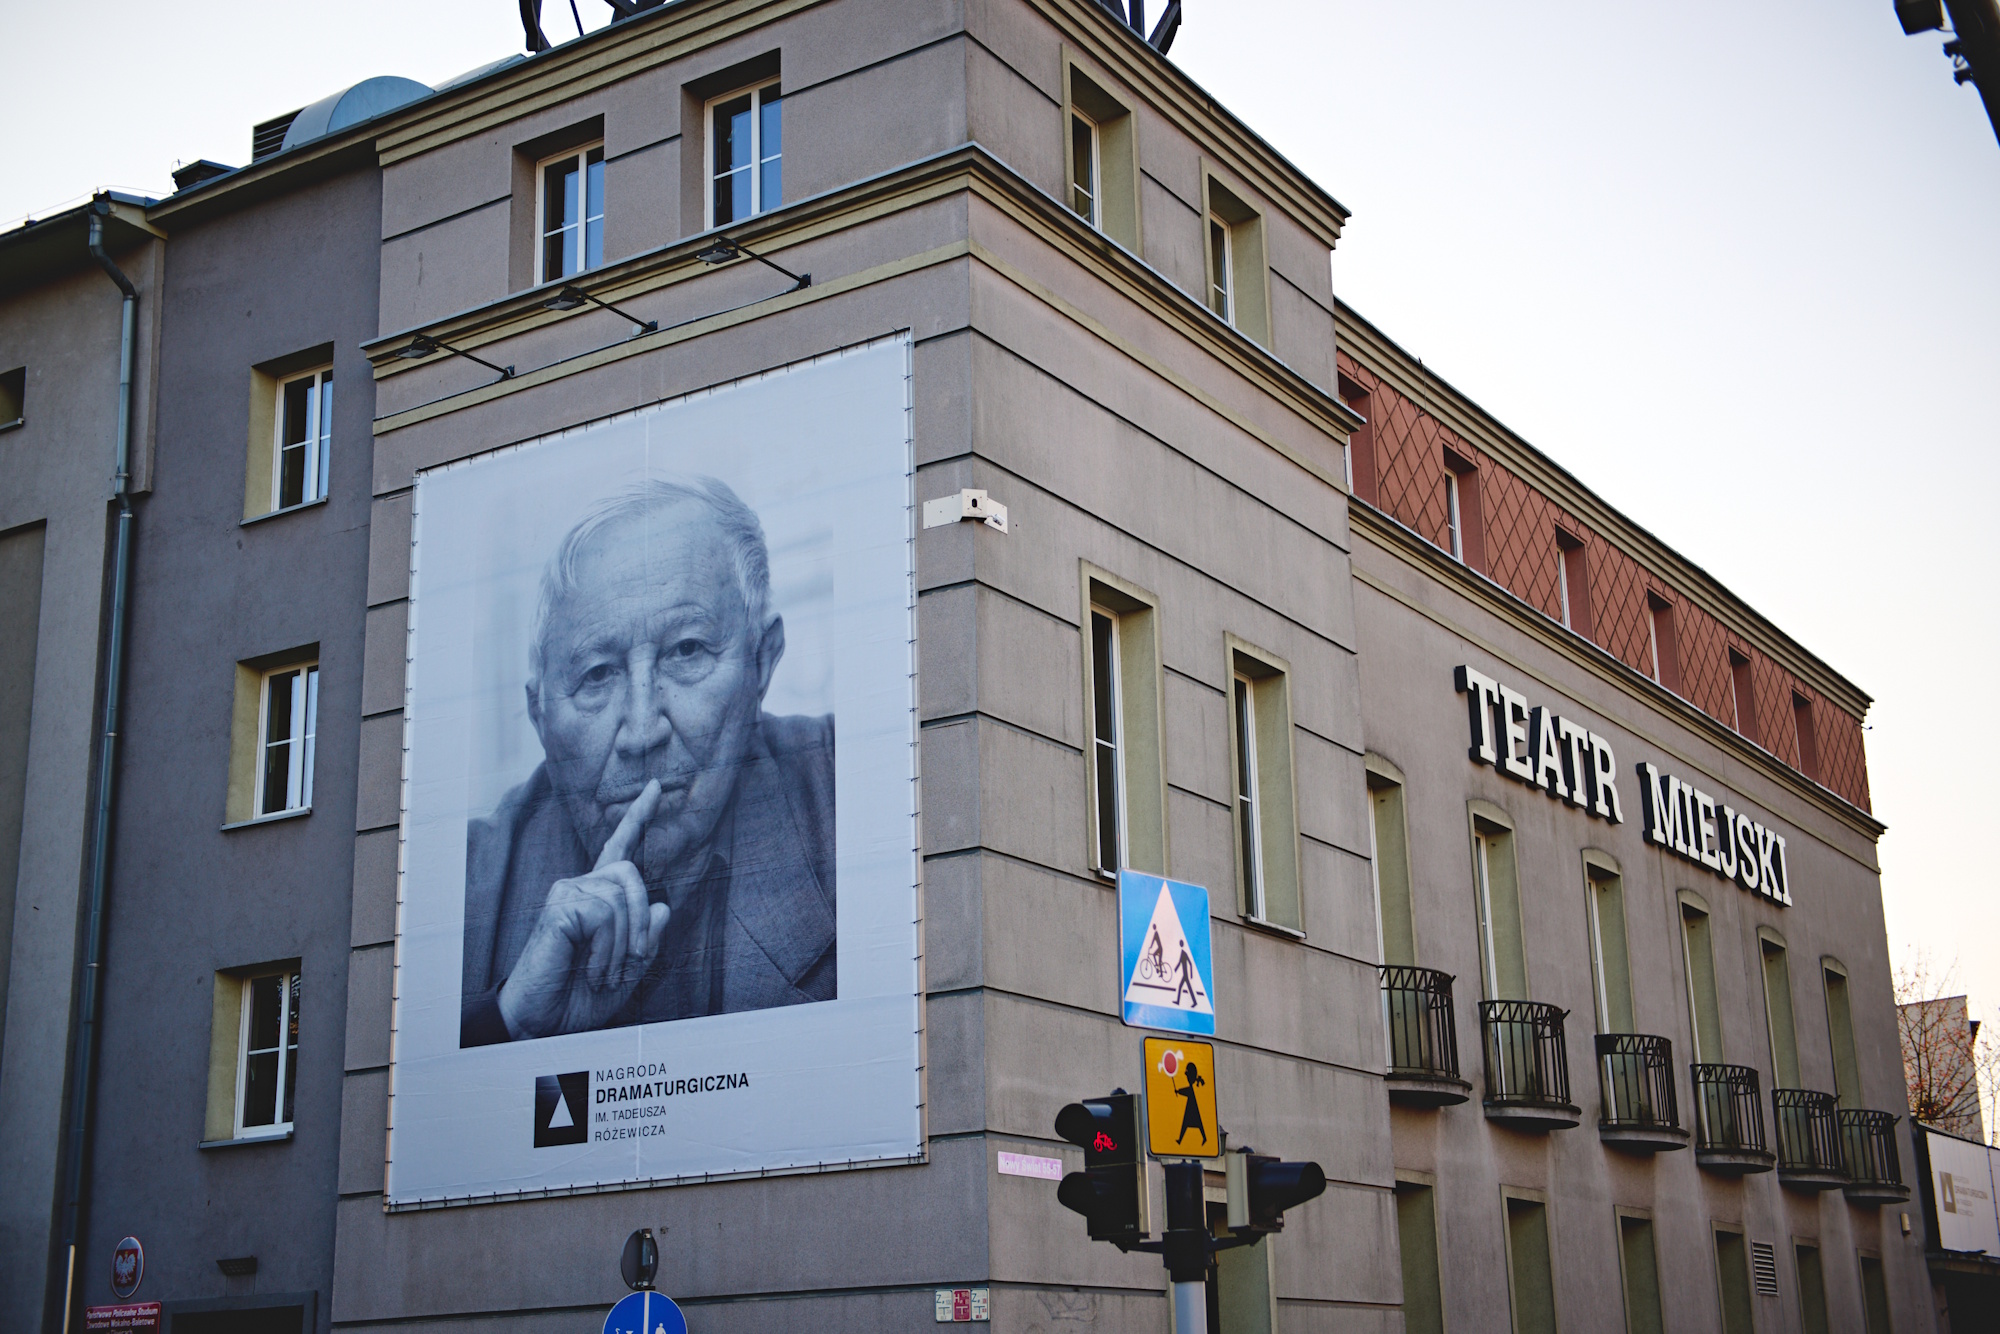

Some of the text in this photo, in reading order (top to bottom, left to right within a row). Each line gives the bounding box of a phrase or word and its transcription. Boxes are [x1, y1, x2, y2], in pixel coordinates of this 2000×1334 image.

[1456, 664, 1793, 908] TEATR MIEJSKI
[596, 1062, 667, 1082] NAGRODA
[596, 1072, 749, 1104] DRAMATURGICZNA
[595, 1105, 667, 1123] IM. TADEUSZA
[595, 1124, 666, 1142] RÓŻEWICZA
[1000, 1156, 1020, 1173] Nowy
[1021, 1157, 1041, 1174] Świat
[137, 1307, 158, 1316] Studium
